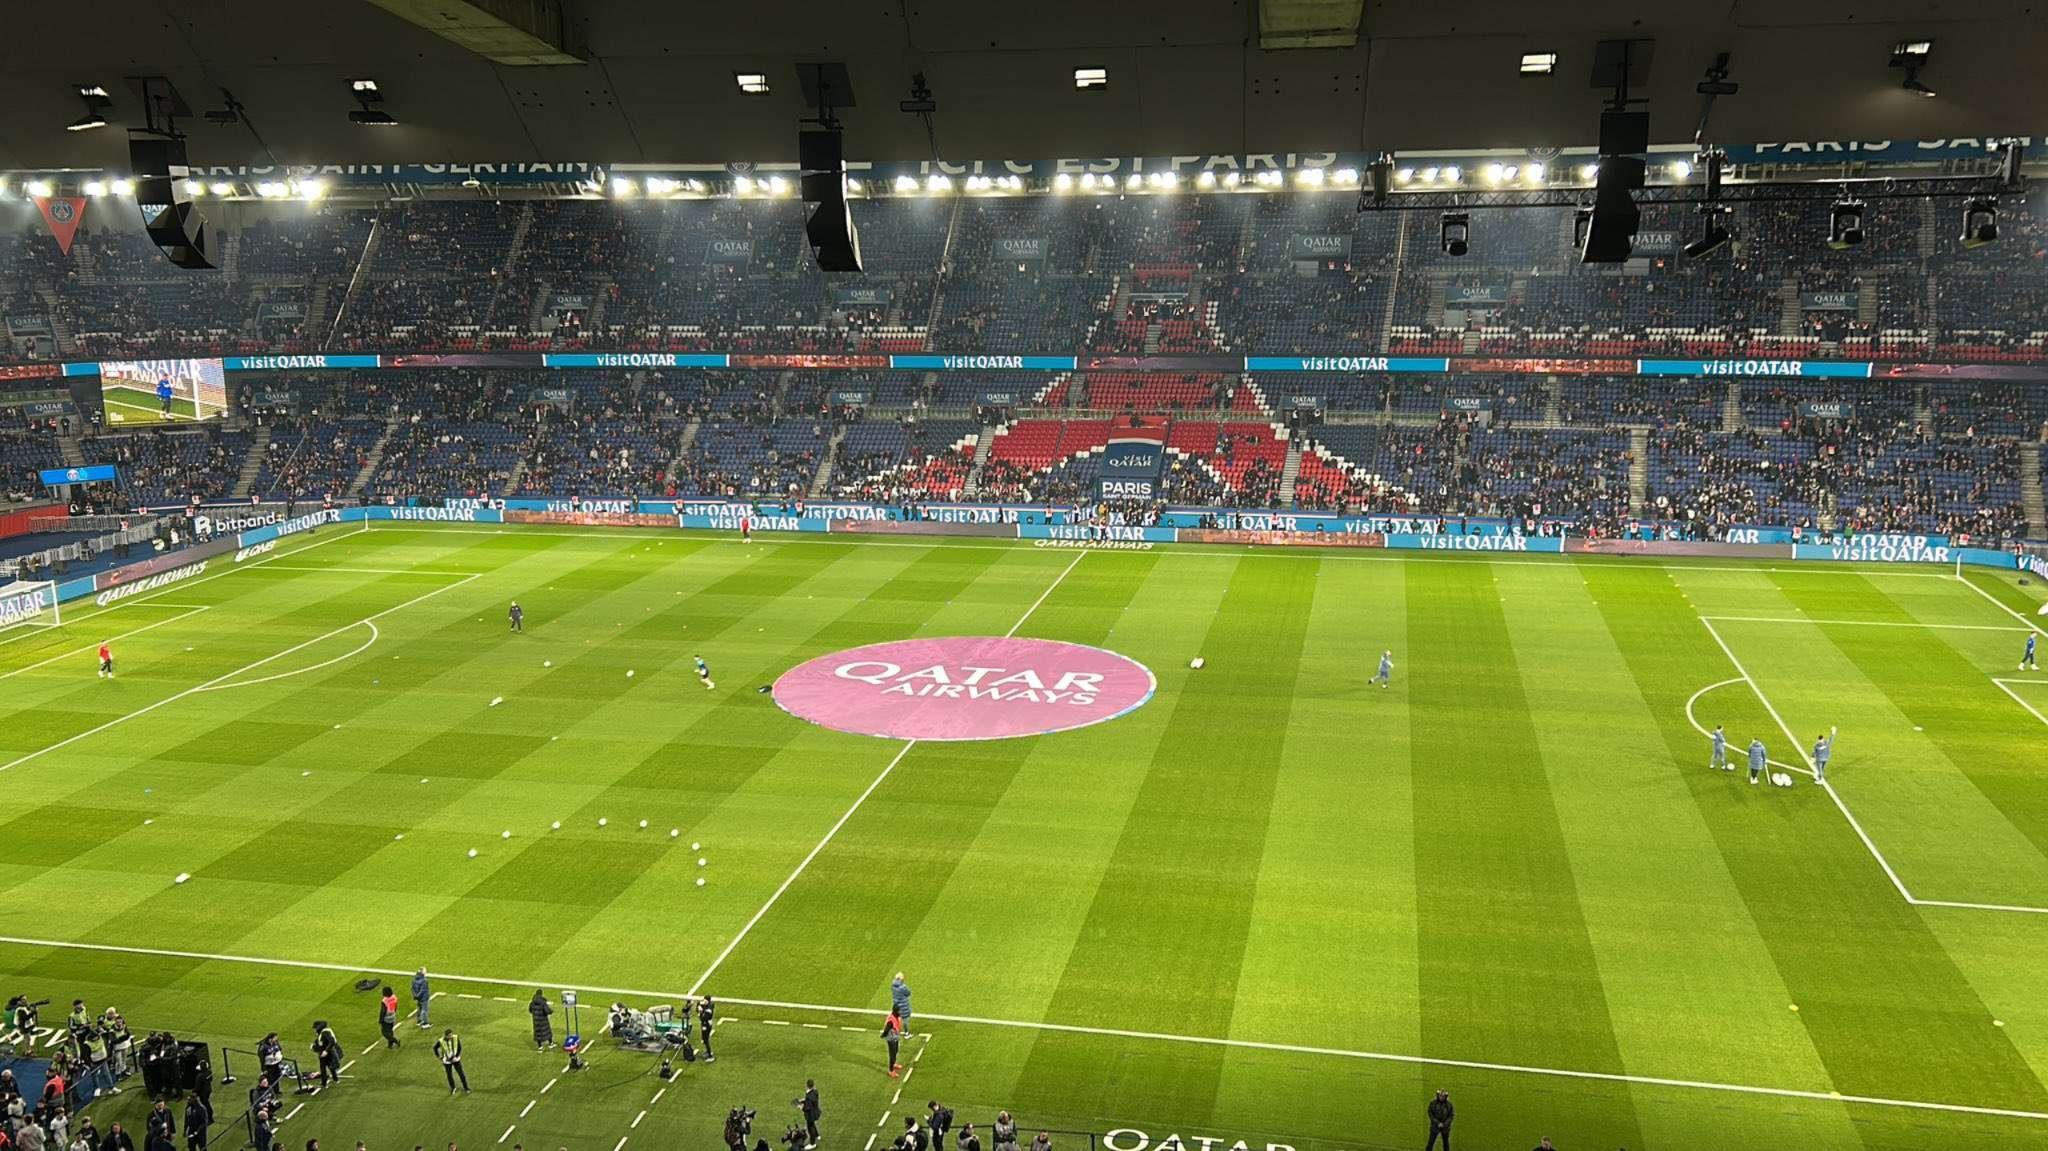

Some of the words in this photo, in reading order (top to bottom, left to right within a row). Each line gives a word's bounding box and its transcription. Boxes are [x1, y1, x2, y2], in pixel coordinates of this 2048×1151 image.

[714, 242, 750, 252] QATAR
[1003, 240, 1040, 250] QATAR
[1303, 237, 1342, 249] QATAR
[241, 355, 326, 369] visitQATAR
[597, 353, 677, 367] visitQATAR
[943, 355, 1024, 369] visitQATAR
[1302, 356, 1389, 371] visitQATAR
[1702, 360, 1802, 376] visitQATAR
[1454, 398, 1480, 407] QATAR
[1811, 404, 1841, 413] QATAR
[1102, 481, 1152, 495] PARIS
[390, 506, 475, 521] visitQATAR
[709, 515, 800, 531] visiQATAR
[1049, 524, 1145, 541] visitATAR
[1420, 535, 1527, 551] visitQATAR
[1832, 545, 1950, 562] visitQATAR
[833, 661, 1106, 692] QATAR
[881, 682, 1098, 706] AIRWAYS
[1102, 1128, 1300, 1151] QAT
